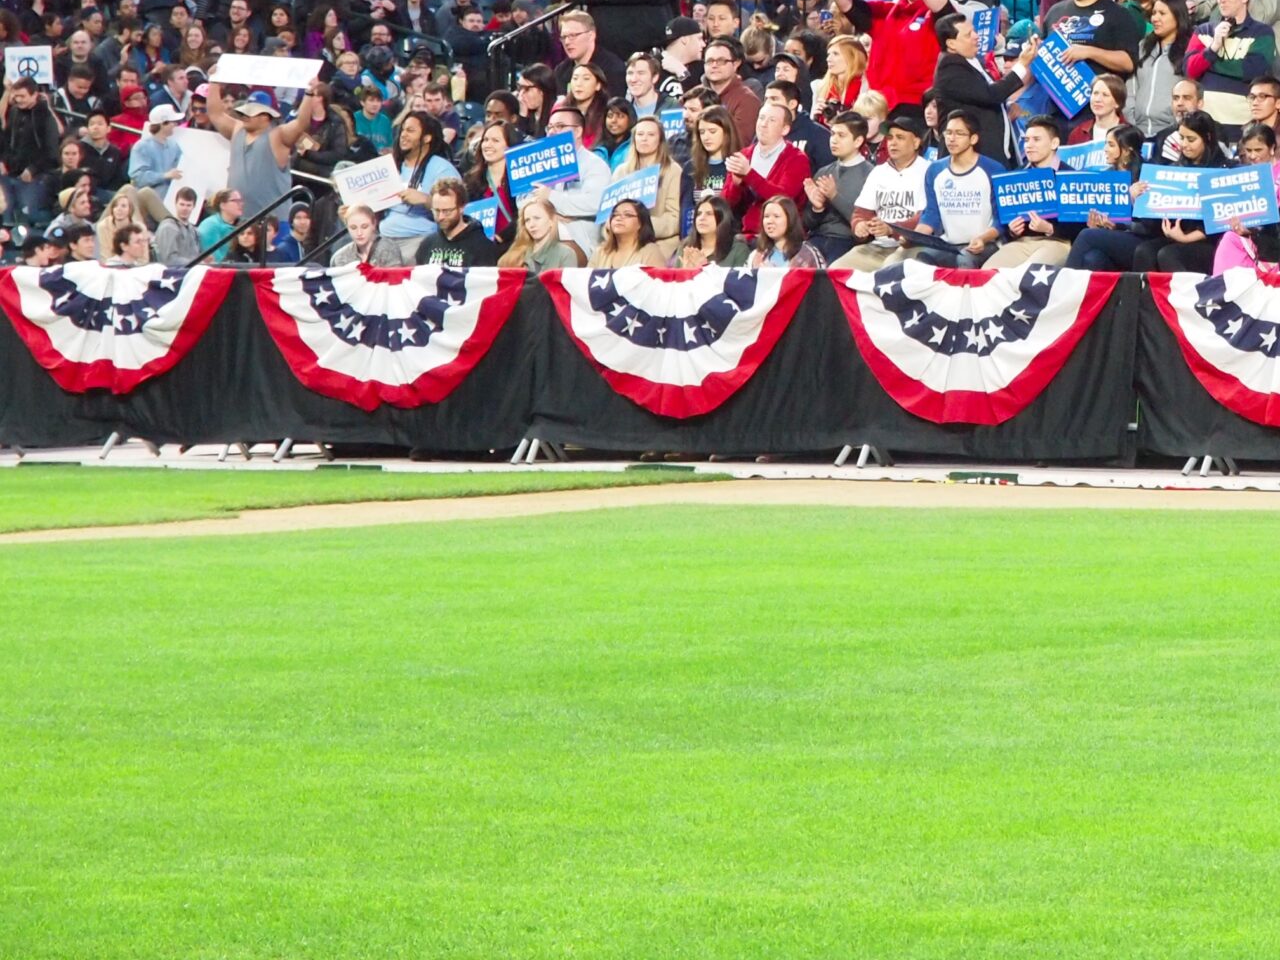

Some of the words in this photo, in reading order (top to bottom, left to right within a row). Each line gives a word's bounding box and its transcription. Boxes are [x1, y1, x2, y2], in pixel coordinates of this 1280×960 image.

[985, 11, 992, 24] IN
[1037, 46, 1076, 92] BELIEVE
[1072, 90, 1087, 106] IN
[1046, 40, 1055, 50] A
[1051, 47, 1082, 85] FUURE
[1080, 81, 1091, 96] TO
[510, 159, 517, 169] A
[518, 147, 557, 166] FUTURE
[558, 143, 573, 153] TO
[511, 158, 559, 180] BELIEVE
[560, 153, 575, 165] IN
[345, 167, 389, 190] Bernie
[610, 180, 643, 199] FUTURE
[645, 175, 657, 186] TO
[998, 185, 1004, 194] A
[1005, 181, 1040, 193] FUTURE
[1041, 180, 1054, 189] TO
[1210, 171, 1259, 189] SIKHS
[1241, 182, 1260, 192] FOR
[643, 184, 656, 197] IN
[1060, 183, 1067, 192] A
[1070, 183, 1111, 192] FUTURE
[1113, 183, 1128, 193] TO
[875, 190, 915, 207] MUSLIM
[999, 191, 1043, 207] BELIEVE
[1045, 190, 1056, 201] IN
[1060, 194, 1112, 205] BELIEVE
[1115, 194, 1129, 205] IN
[1147, 192, 1202, 209] Berni
[1212, 195, 1268, 219] Bernie
[484, 208, 495, 217] TO
